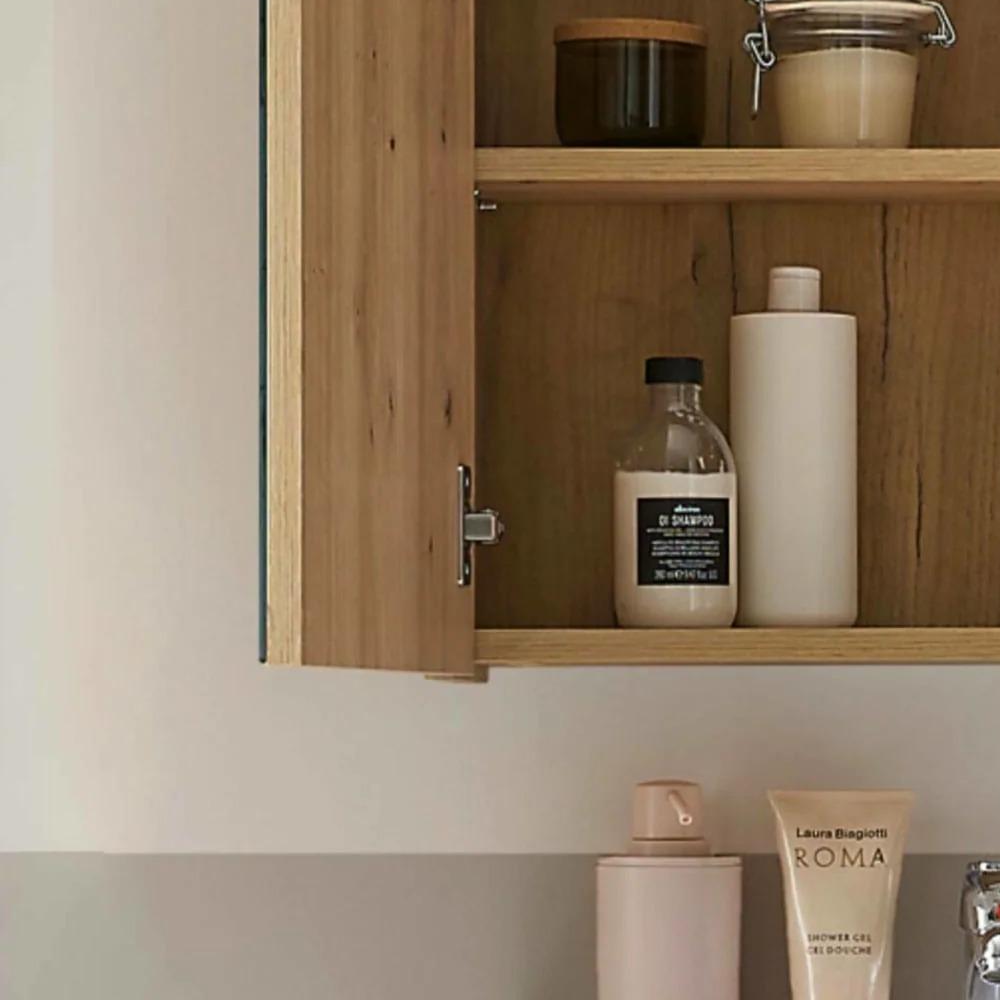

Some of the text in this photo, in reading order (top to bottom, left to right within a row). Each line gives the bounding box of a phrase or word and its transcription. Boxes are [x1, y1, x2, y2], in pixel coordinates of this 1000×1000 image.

[671, 514, 714, 526] SHAMPOO
[796, 827, 888, 841] Laura Biagiotti
[794, 846, 887, 868] ROMA
[808, 933, 872, 943] SHOWER GEL
